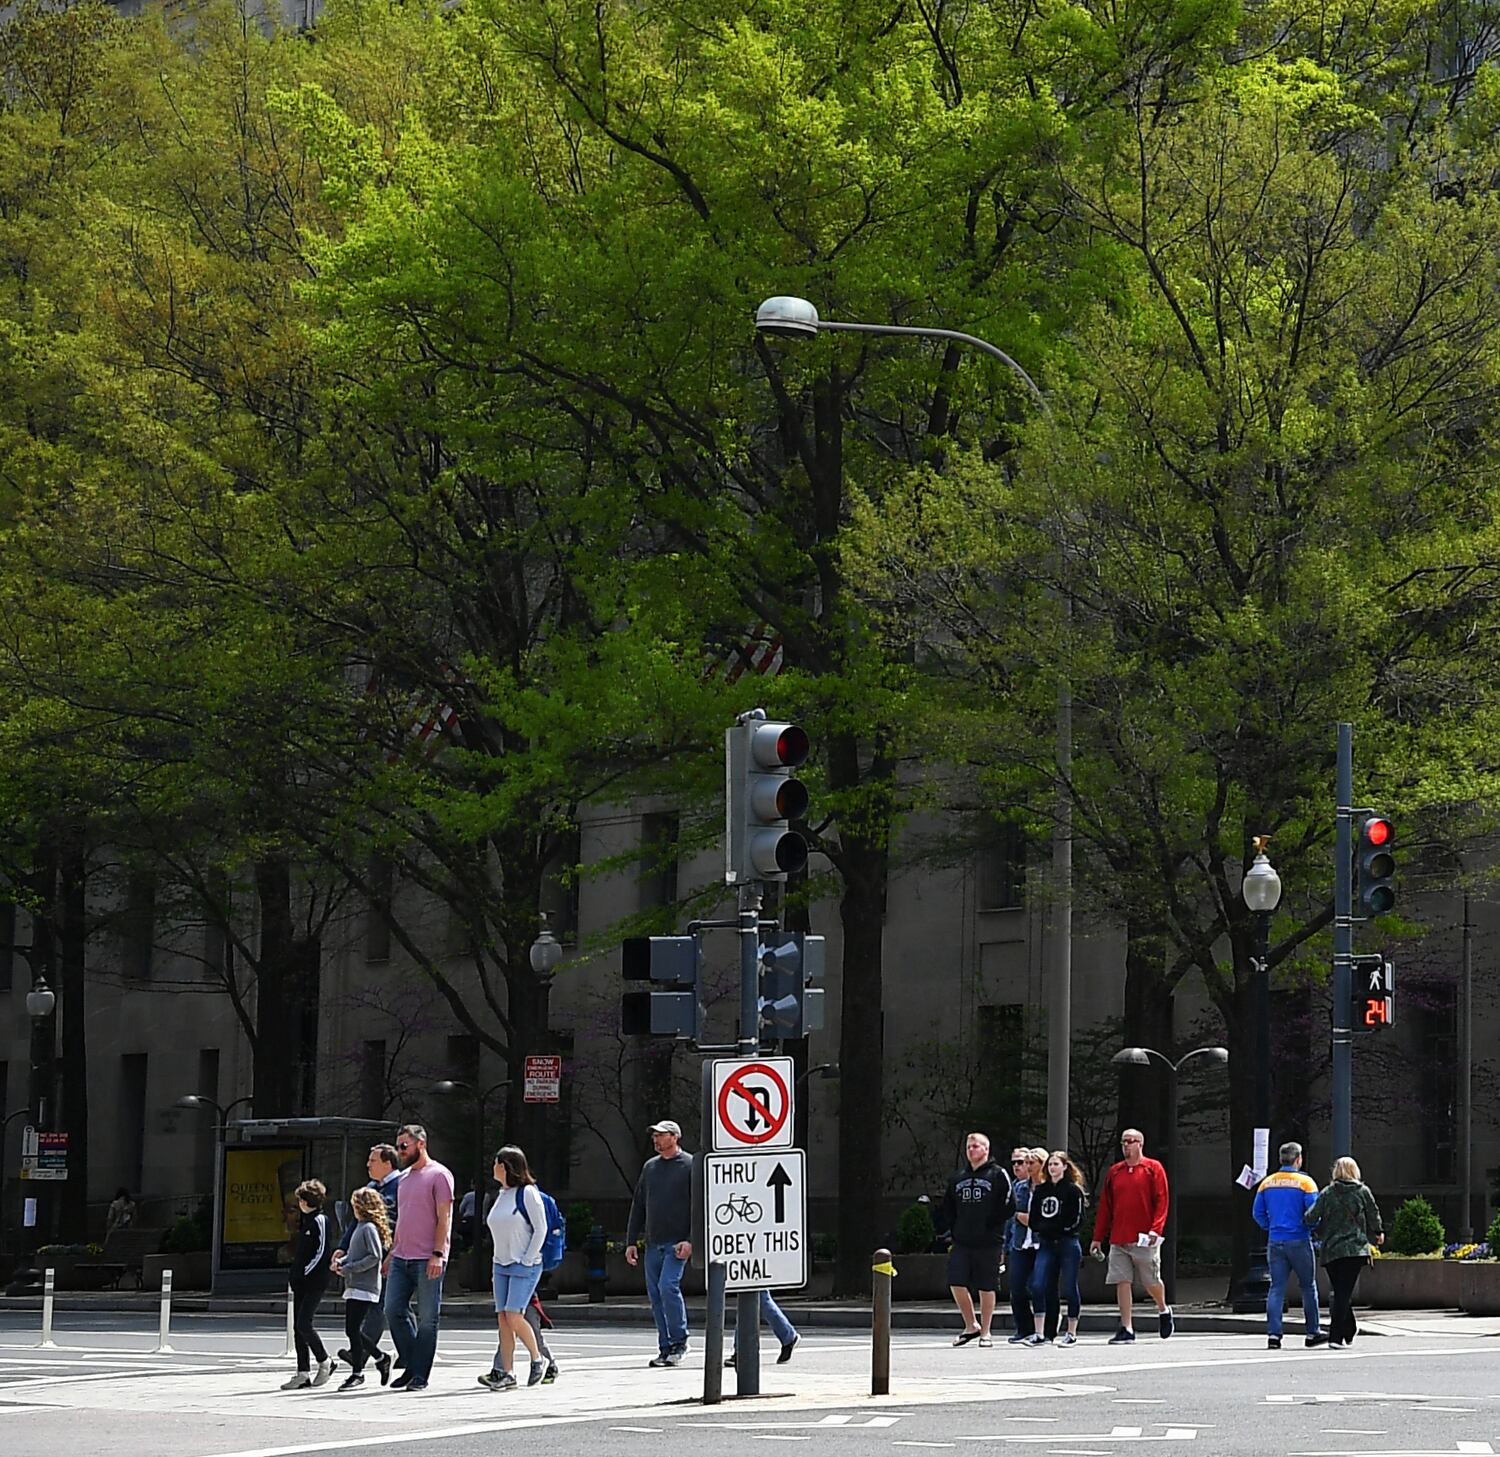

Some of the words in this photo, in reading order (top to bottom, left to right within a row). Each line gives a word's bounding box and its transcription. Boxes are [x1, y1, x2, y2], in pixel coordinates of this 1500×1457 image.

[1366, 1000, 1385, 1024] 24
[712, 1162, 756, 1184] THRU
[962, 1187, 982, 1200] DC
[712, 1232, 756, 1255] OBEY
[763, 1231, 799, 1252] THIS
[724, 1258, 772, 1281] IGNAL
